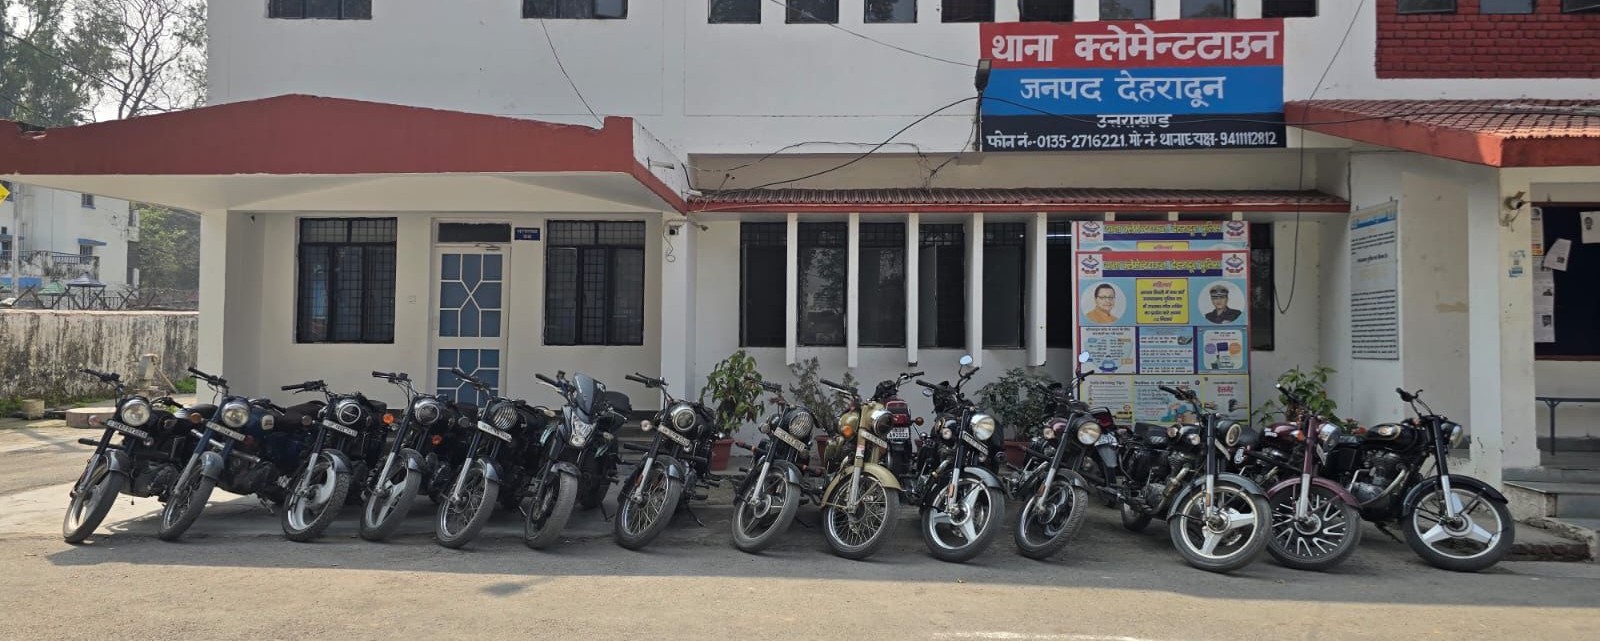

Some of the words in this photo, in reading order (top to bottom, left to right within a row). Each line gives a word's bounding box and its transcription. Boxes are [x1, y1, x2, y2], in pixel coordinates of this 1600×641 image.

[992, 35, 1059, 62] थाना
[1074, 23, 1280, 61] क्लेमेन्टटाउन
[1020, 77, 1104, 102] जनपद
[1114, 69, 1227, 108] देहरादून
[986, 130, 1016, 148] फोन
